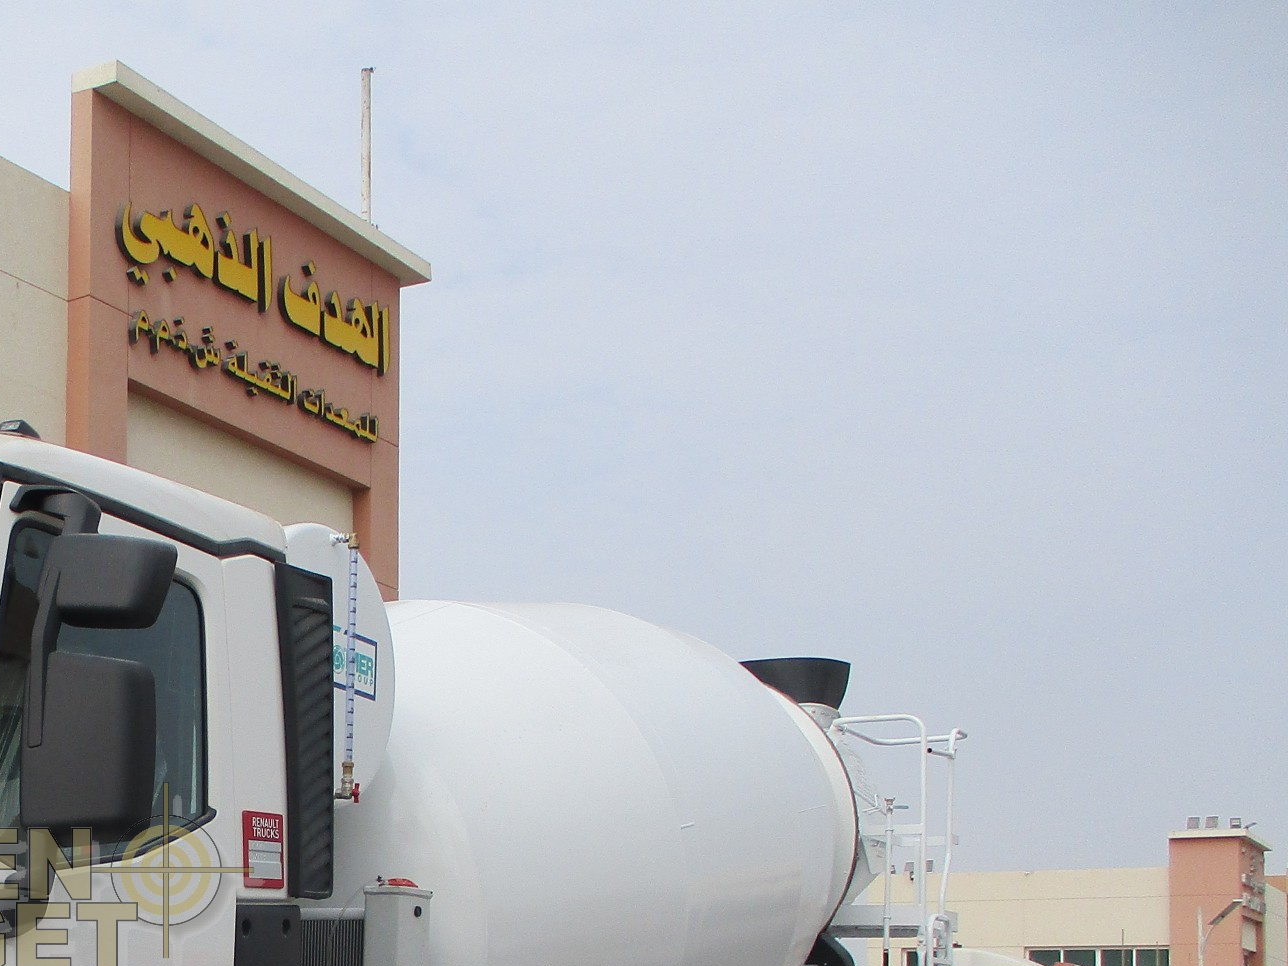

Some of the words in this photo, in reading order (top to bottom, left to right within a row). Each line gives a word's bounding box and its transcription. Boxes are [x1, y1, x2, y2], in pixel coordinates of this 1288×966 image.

[116, 201, 272, 314] الذهبي
[279, 260, 390, 376] الهدف
[298, 388, 380, 443] للمعدات
[252, 817, 279, 829] RENAULT
[253, 828, 280, 839] TRUCKS
